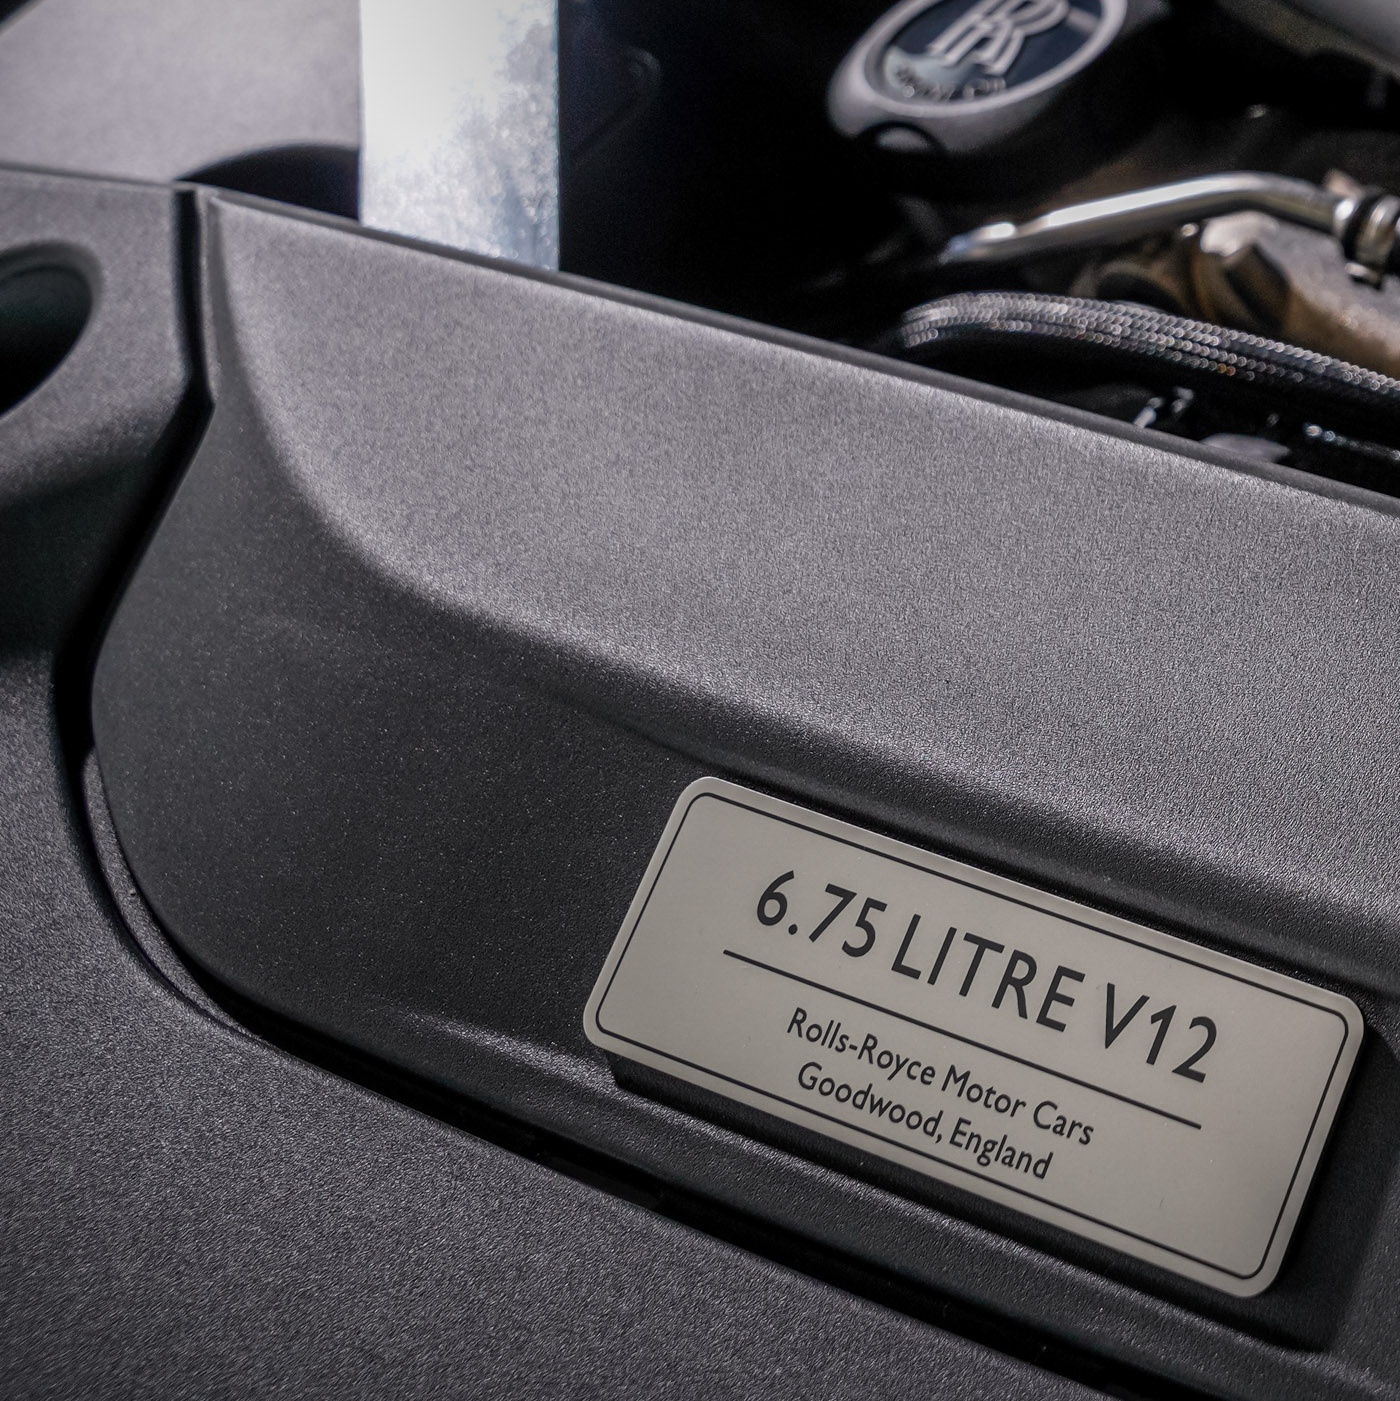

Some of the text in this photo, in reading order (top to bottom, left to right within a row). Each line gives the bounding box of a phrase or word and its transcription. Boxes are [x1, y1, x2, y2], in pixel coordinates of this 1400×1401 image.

[755, 868, 1218, 1085] 6.75 LITRE V12
[786, 1006, 1095, 1147] Rolls-Royce Motor Cars
[797, 1061, 1055, 1181] Goodwood, England
